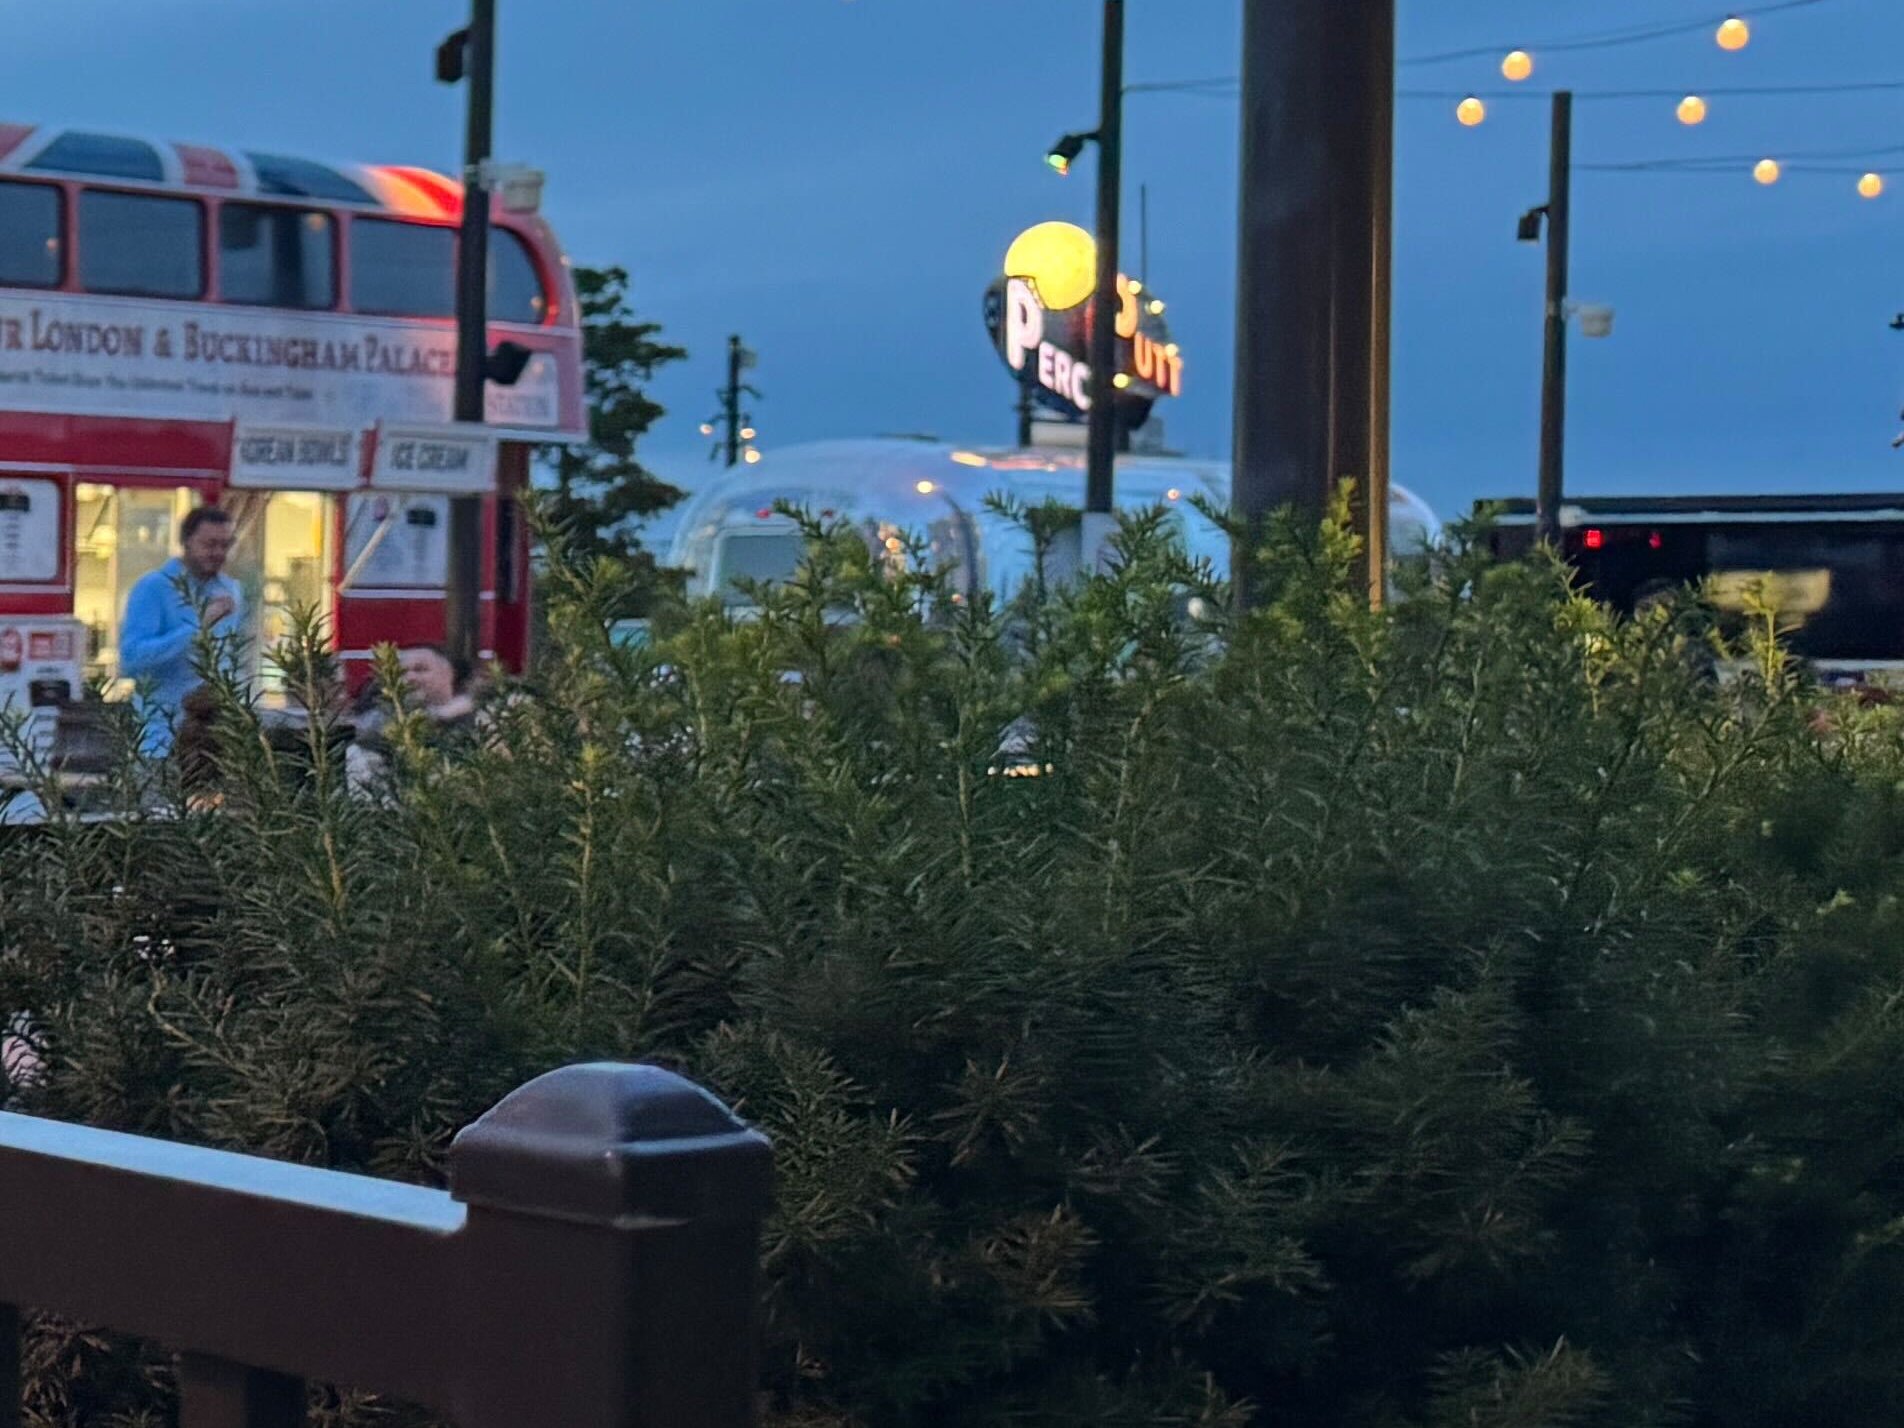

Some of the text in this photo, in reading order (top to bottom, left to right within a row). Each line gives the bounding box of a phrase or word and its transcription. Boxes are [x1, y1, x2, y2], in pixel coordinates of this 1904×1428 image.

[30, 308, 145, 357] LONDON
[184, 321, 361, 371] BUCKINGHAM
[1006, 277, 1092, 413] PERC
